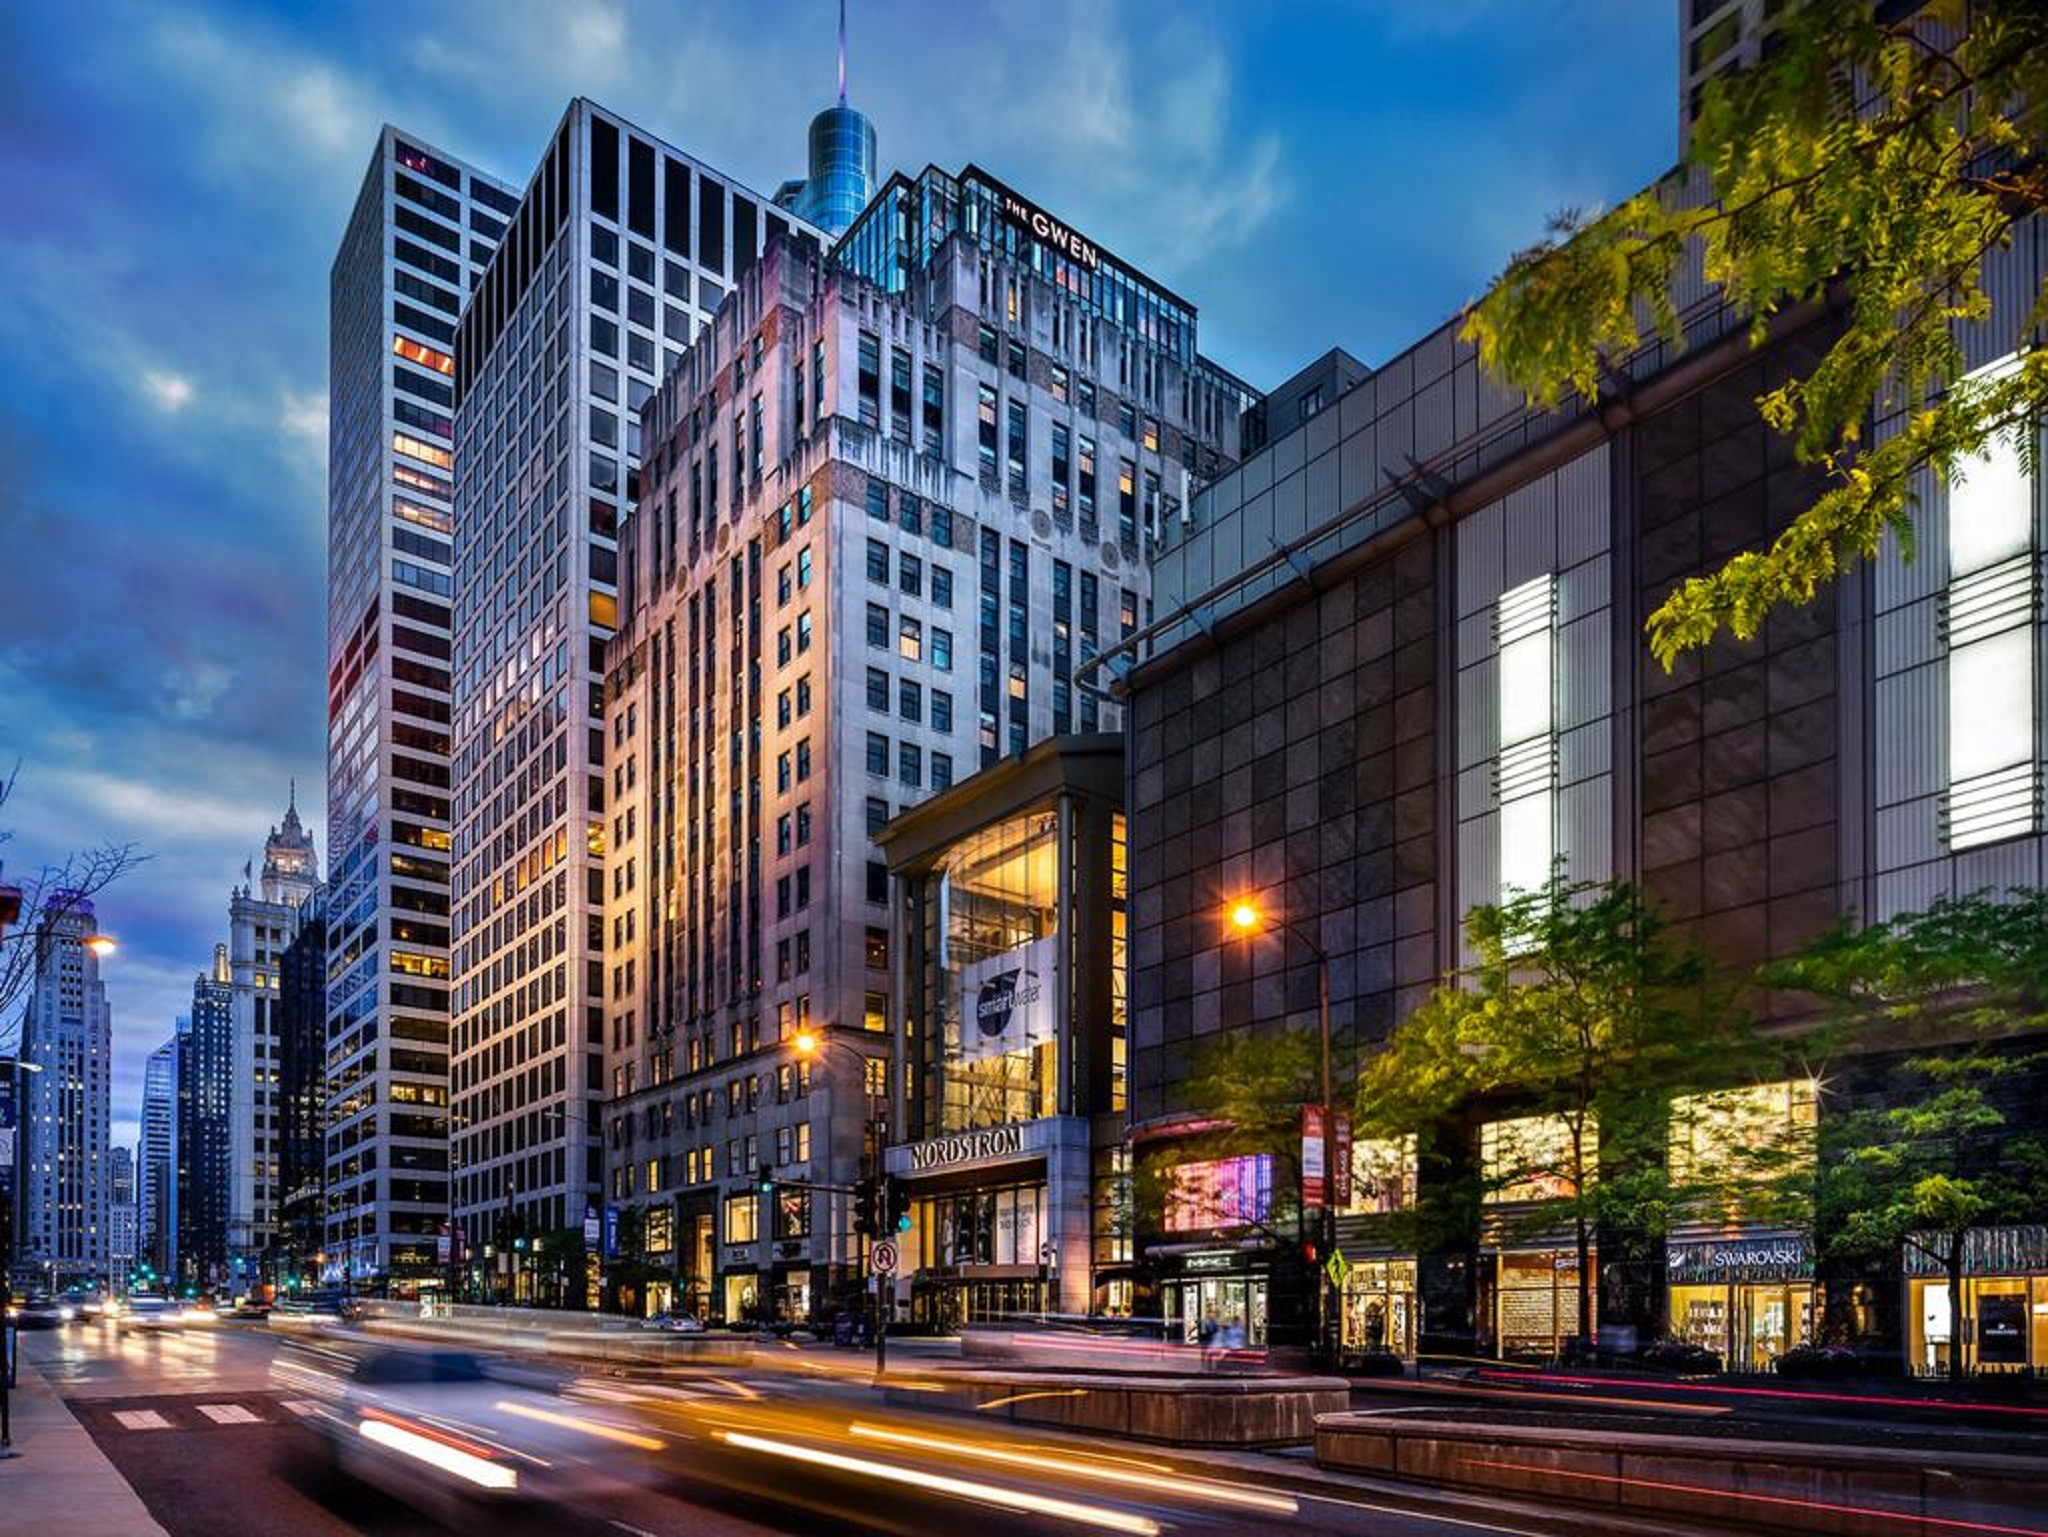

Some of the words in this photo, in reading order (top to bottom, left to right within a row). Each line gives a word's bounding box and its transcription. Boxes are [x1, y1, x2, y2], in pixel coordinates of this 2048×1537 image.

[1006, 198, 1027, 220] THE
[1032, 213, 1096, 268] GWEN
[913, 1127, 1024, 1170] NORDSTROM
[1715, 1250, 1801, 1267] SWAROVSKI
